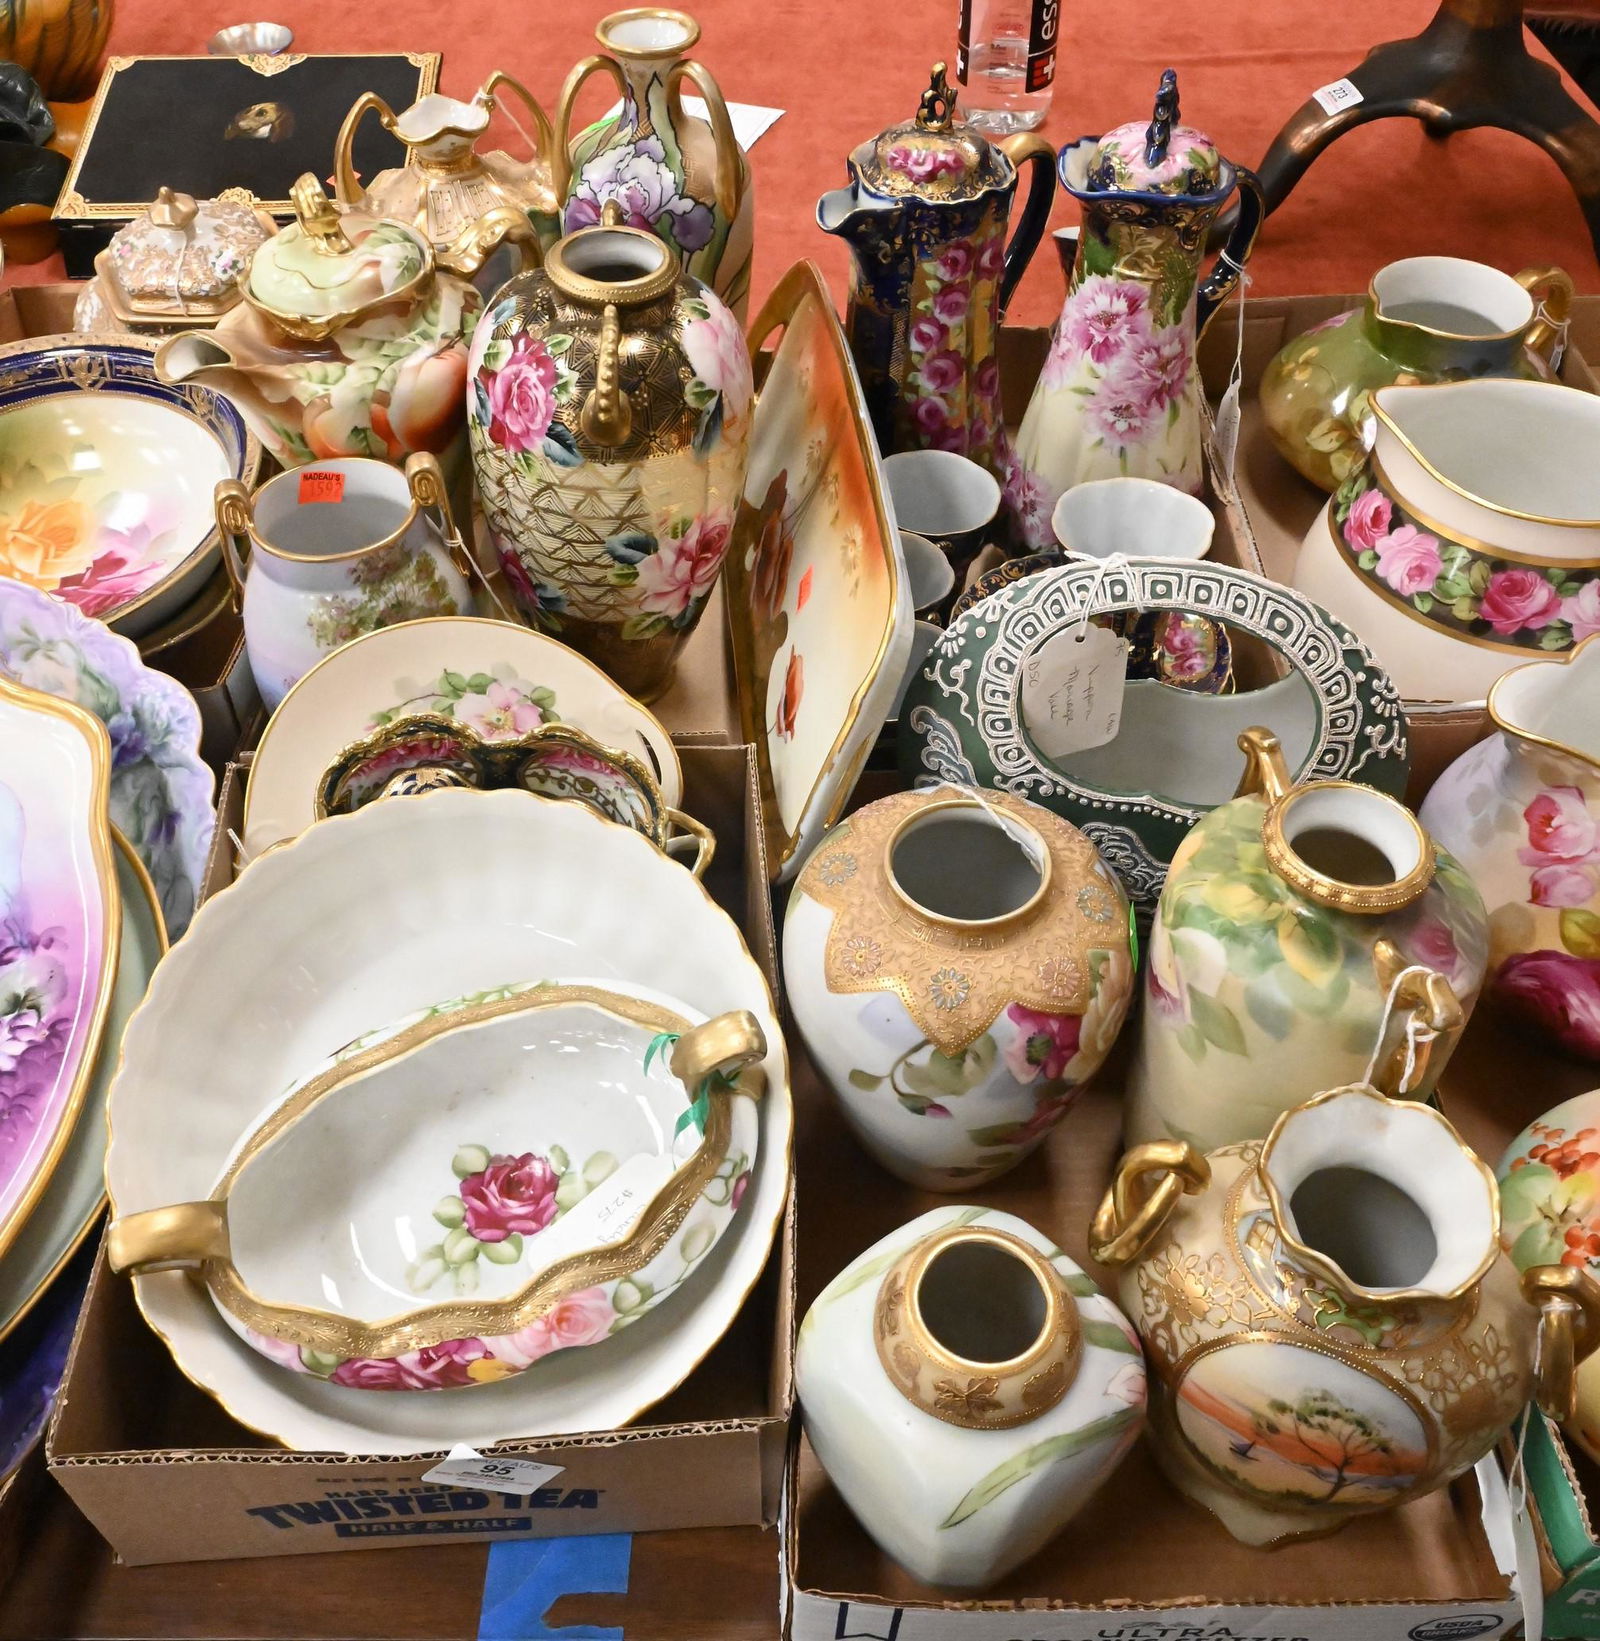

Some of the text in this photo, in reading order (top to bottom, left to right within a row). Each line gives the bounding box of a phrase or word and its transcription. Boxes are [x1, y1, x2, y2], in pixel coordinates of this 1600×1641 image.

[302, 473, 341, 481] NADEAU'S
[480, 1465, 515, 1475] 95
[324, 1485, 453, 1499] HARD ICED
[246, 1488, 599, 1529] TWISTED TEA
[350, 1522, 416, 1533] HALF
[453, 1518, 519, 1530] HALF
[1097, 1627, 1236, 1638] ULTRA
